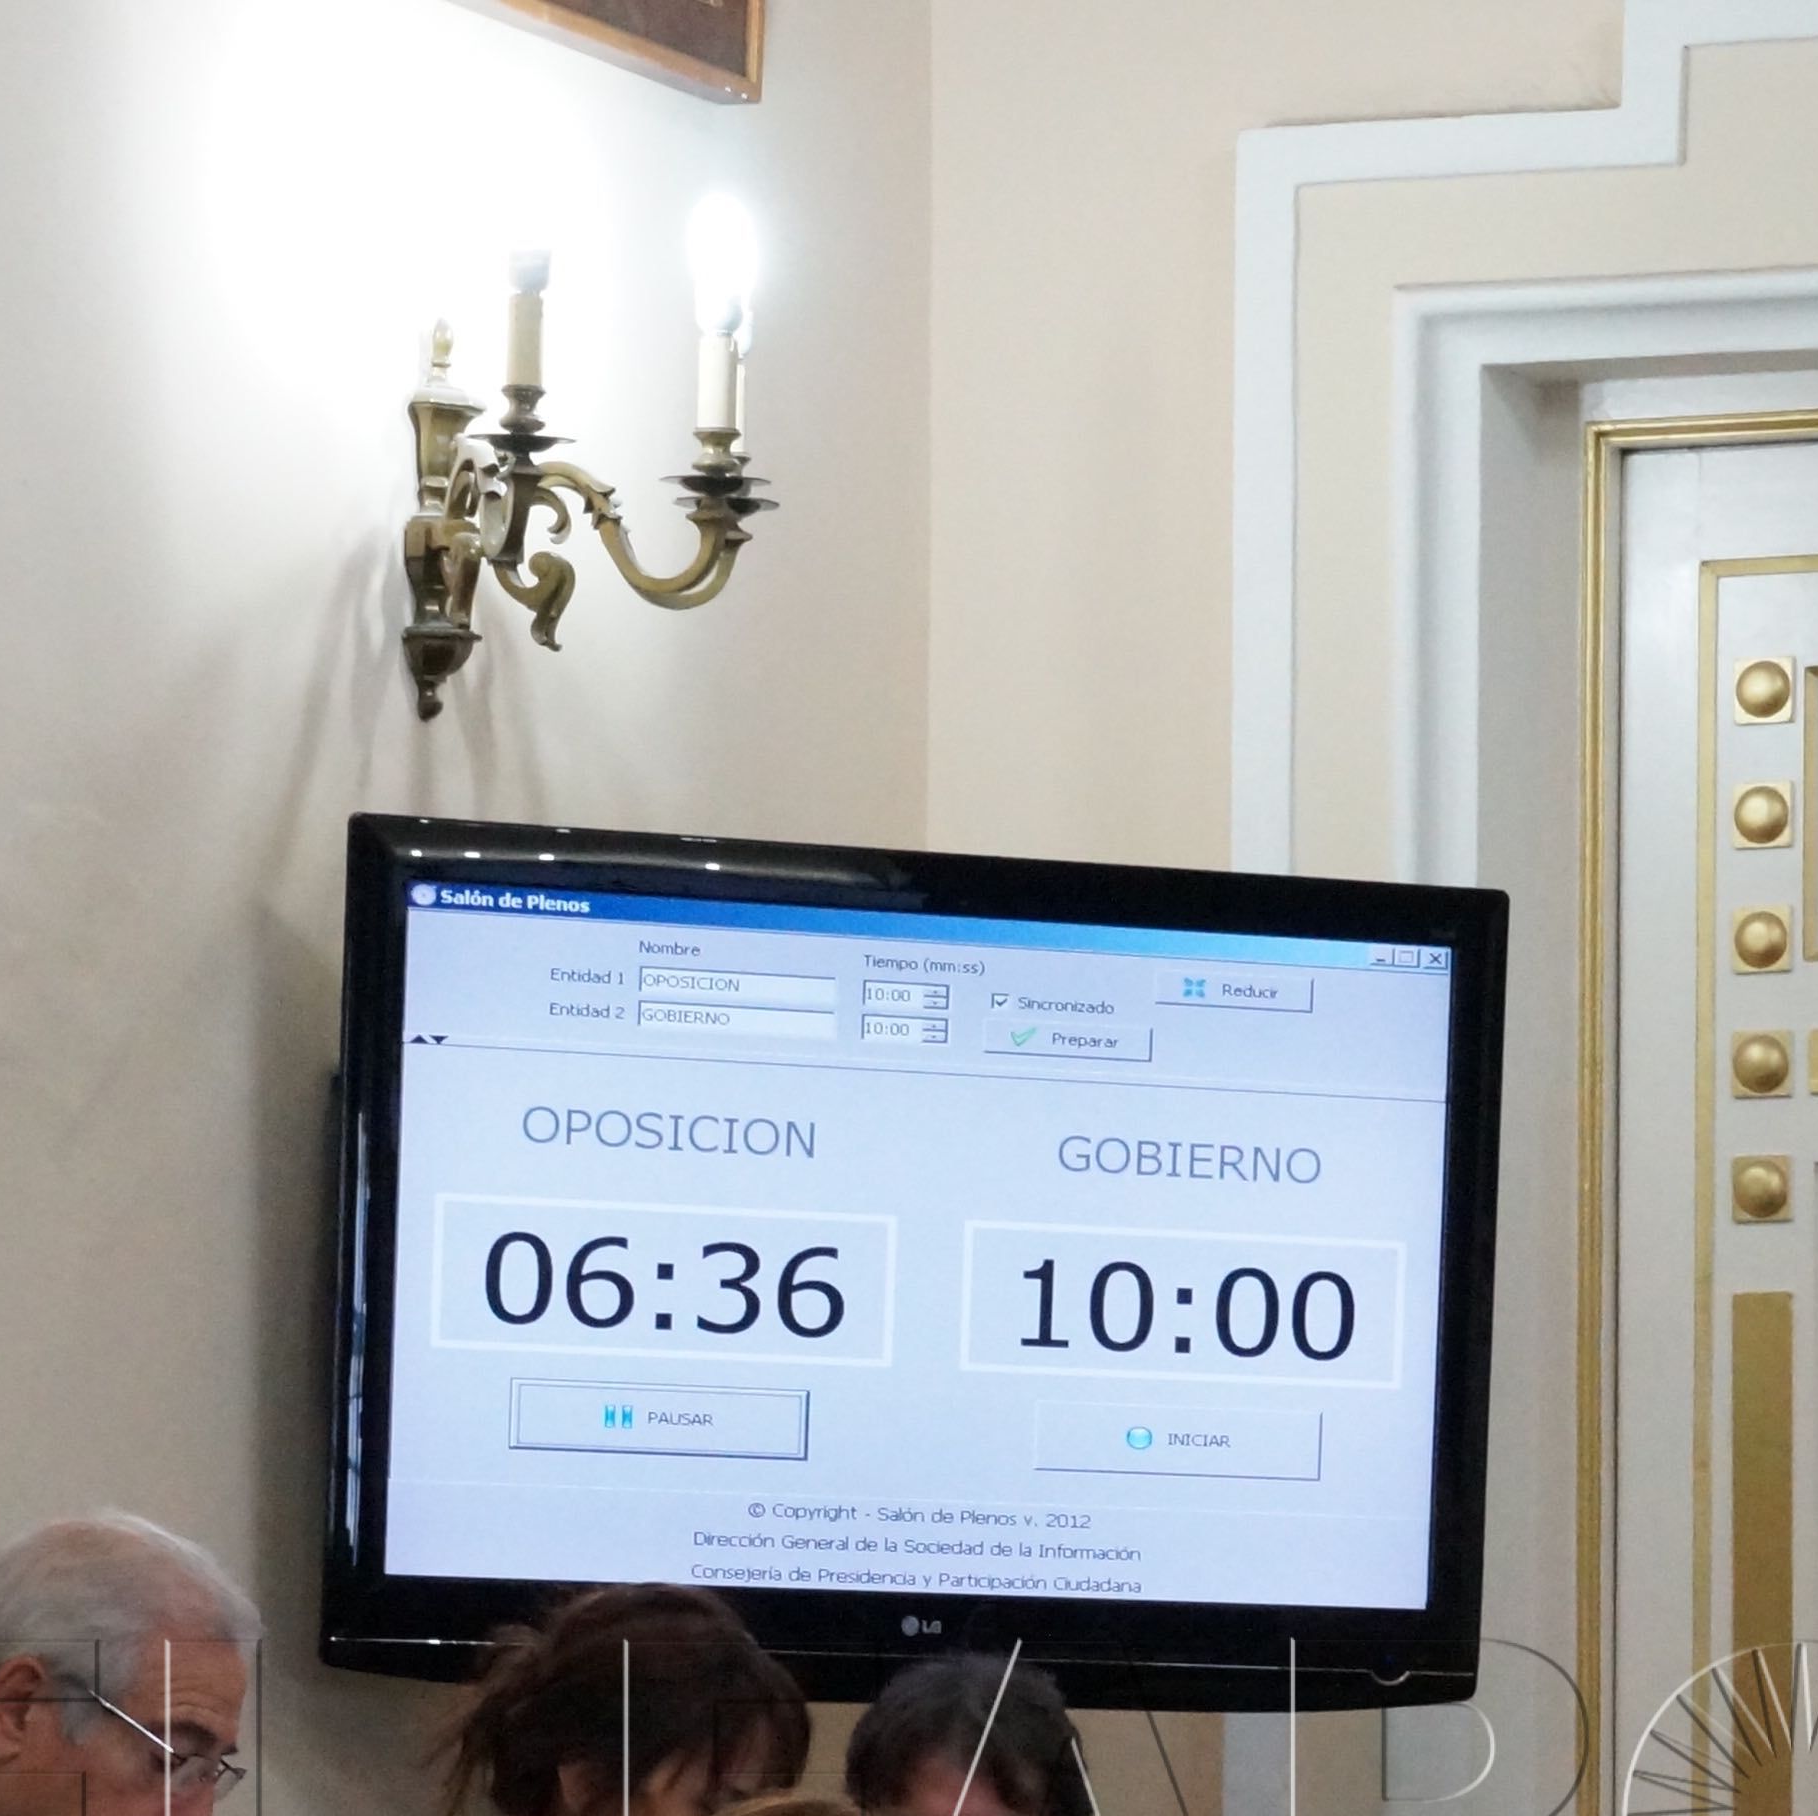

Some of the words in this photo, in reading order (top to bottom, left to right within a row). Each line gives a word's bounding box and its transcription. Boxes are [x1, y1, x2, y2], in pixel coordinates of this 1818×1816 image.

[440, 887, 494, 908] Salón
[498, 893, 523, 909] de
[527, 896, 590, 914] Plenos
[639, 940, 700, 957] Nombre
[864, 954, 919, 972] Tiempo
[923, 957, 986, 976] (mm:ss)
[551, 968, 612, 984] Entidad
[643, 973, 740, 993] OPOSICION
[866, 987, 911, 1002] 10:00
[1222, 984, 1278, 1000] Reducir
[550, 1002, 611, 1019] Entidad
[615, 1006, 625, 1019] 2
[1018, 997, 1115, 1016] Sincronizado
[641, 1007, 730, 1026] GOBIERNO
[865, 1021, 910, 1037] 10:00
[1052, 1033, 1118, 1052] Preparar
[522, 1106, 816, 1159] OPOSICION
[1058, 1135, 1321, 1184] GOBIERNO
[485, 1231, 845, 1338] 06:36
[1020, 1259, 1355, 1361] 10:00
[648, 1410, 713, 1427] PAUSAR
[1168, 1432, 1231, 1448] INICIAR
[772, 1504, 857, 1522] Copyright
[878, 1507, 925, 1523] Salón
[932, 1509, 954, 1524] de
[960, 1510, 1017, 1526] Plenos
[1046, 1514, 1091, 1529] 2012
[693, 1531, 775, 1549] Dirección
[782, 1535, 849, 1551] General
[856, 1537, 877, 1553] de
[885, 1538, 898, 1553] la
[904, 1539, 984, 1557] Sociedad
[991, 1542, 1012, 1557] de
[1019, 1543, 1032, 1558] la
[1039, 1544, 1141, 1562] Información
[691, 1564, 783, 1583] Consejería
[789, 1568, 811, 1583] de
[818, 1569, 916, 1586] Presidencia
[923, 1576, 932, 1589] y
[939, 1573, 1046, 1592] Participación
[1054, 1576, 1141, 1594] Ciudadana
